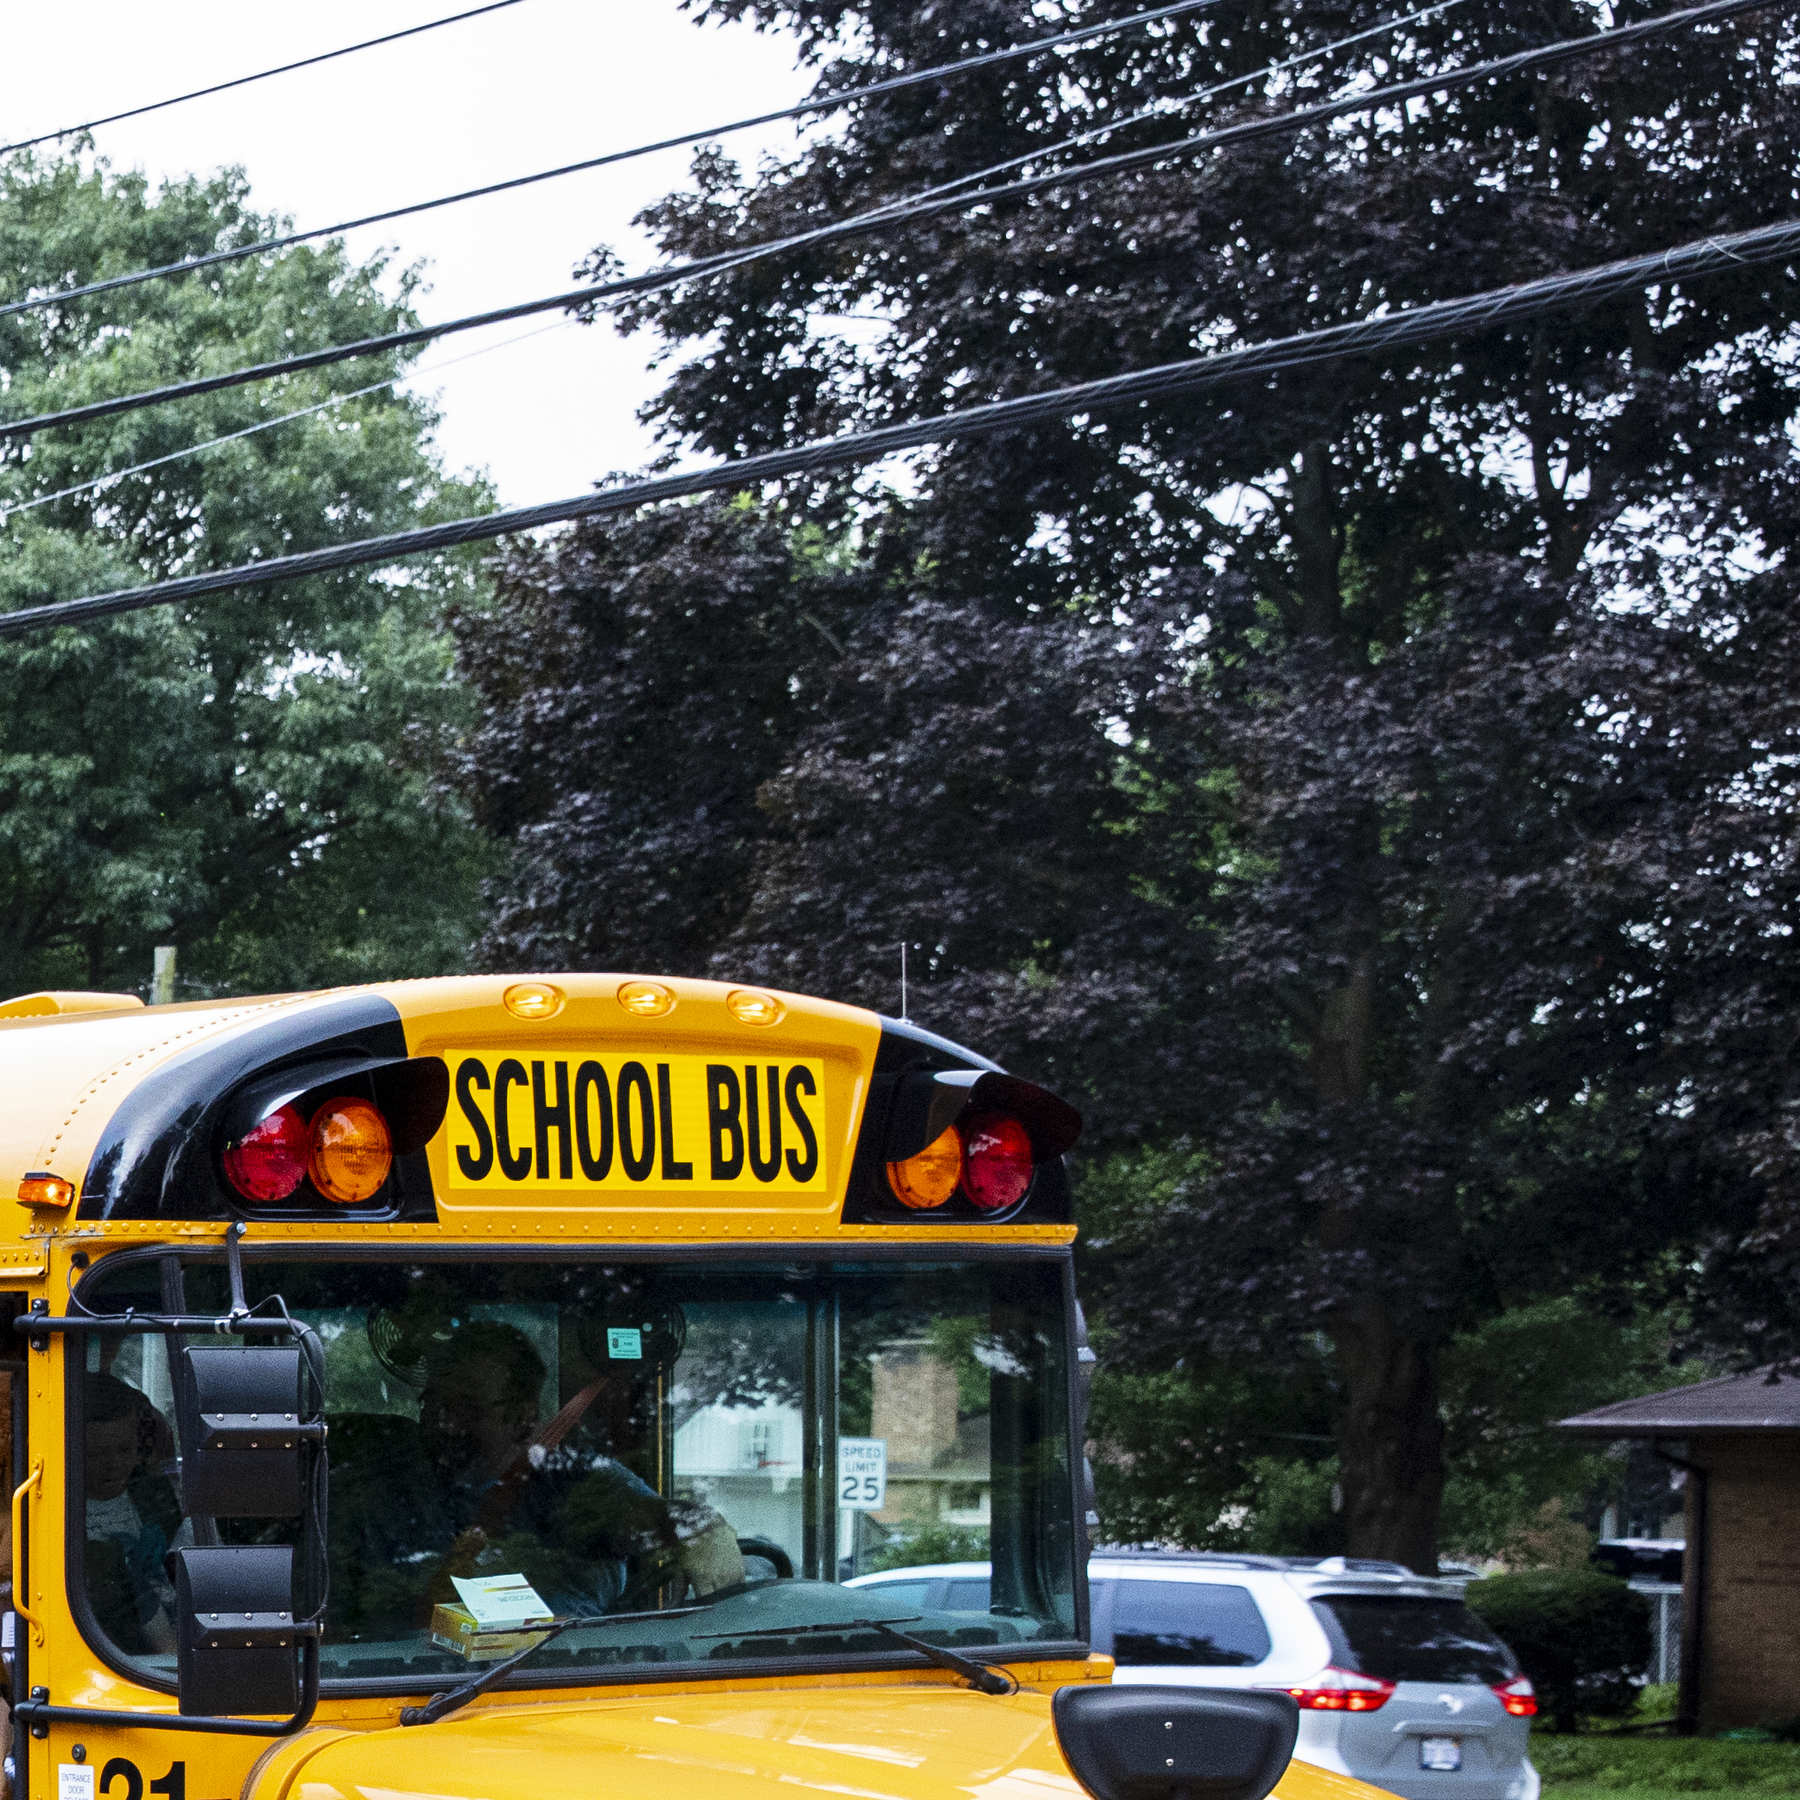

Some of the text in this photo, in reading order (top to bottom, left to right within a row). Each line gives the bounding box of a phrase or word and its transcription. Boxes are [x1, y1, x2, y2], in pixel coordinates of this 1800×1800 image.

[455, 1057, 818, 1183] SCHOOL BUS
[842, 1446, 881, 1458] SPEED
[846, 1462, 877, 1473] LIMIT
[842, 1477, 879, 1500] 25
[62, 1773, 91, 1784] ENTRANCE
[68, 1785, 84, 1794] DOOR
